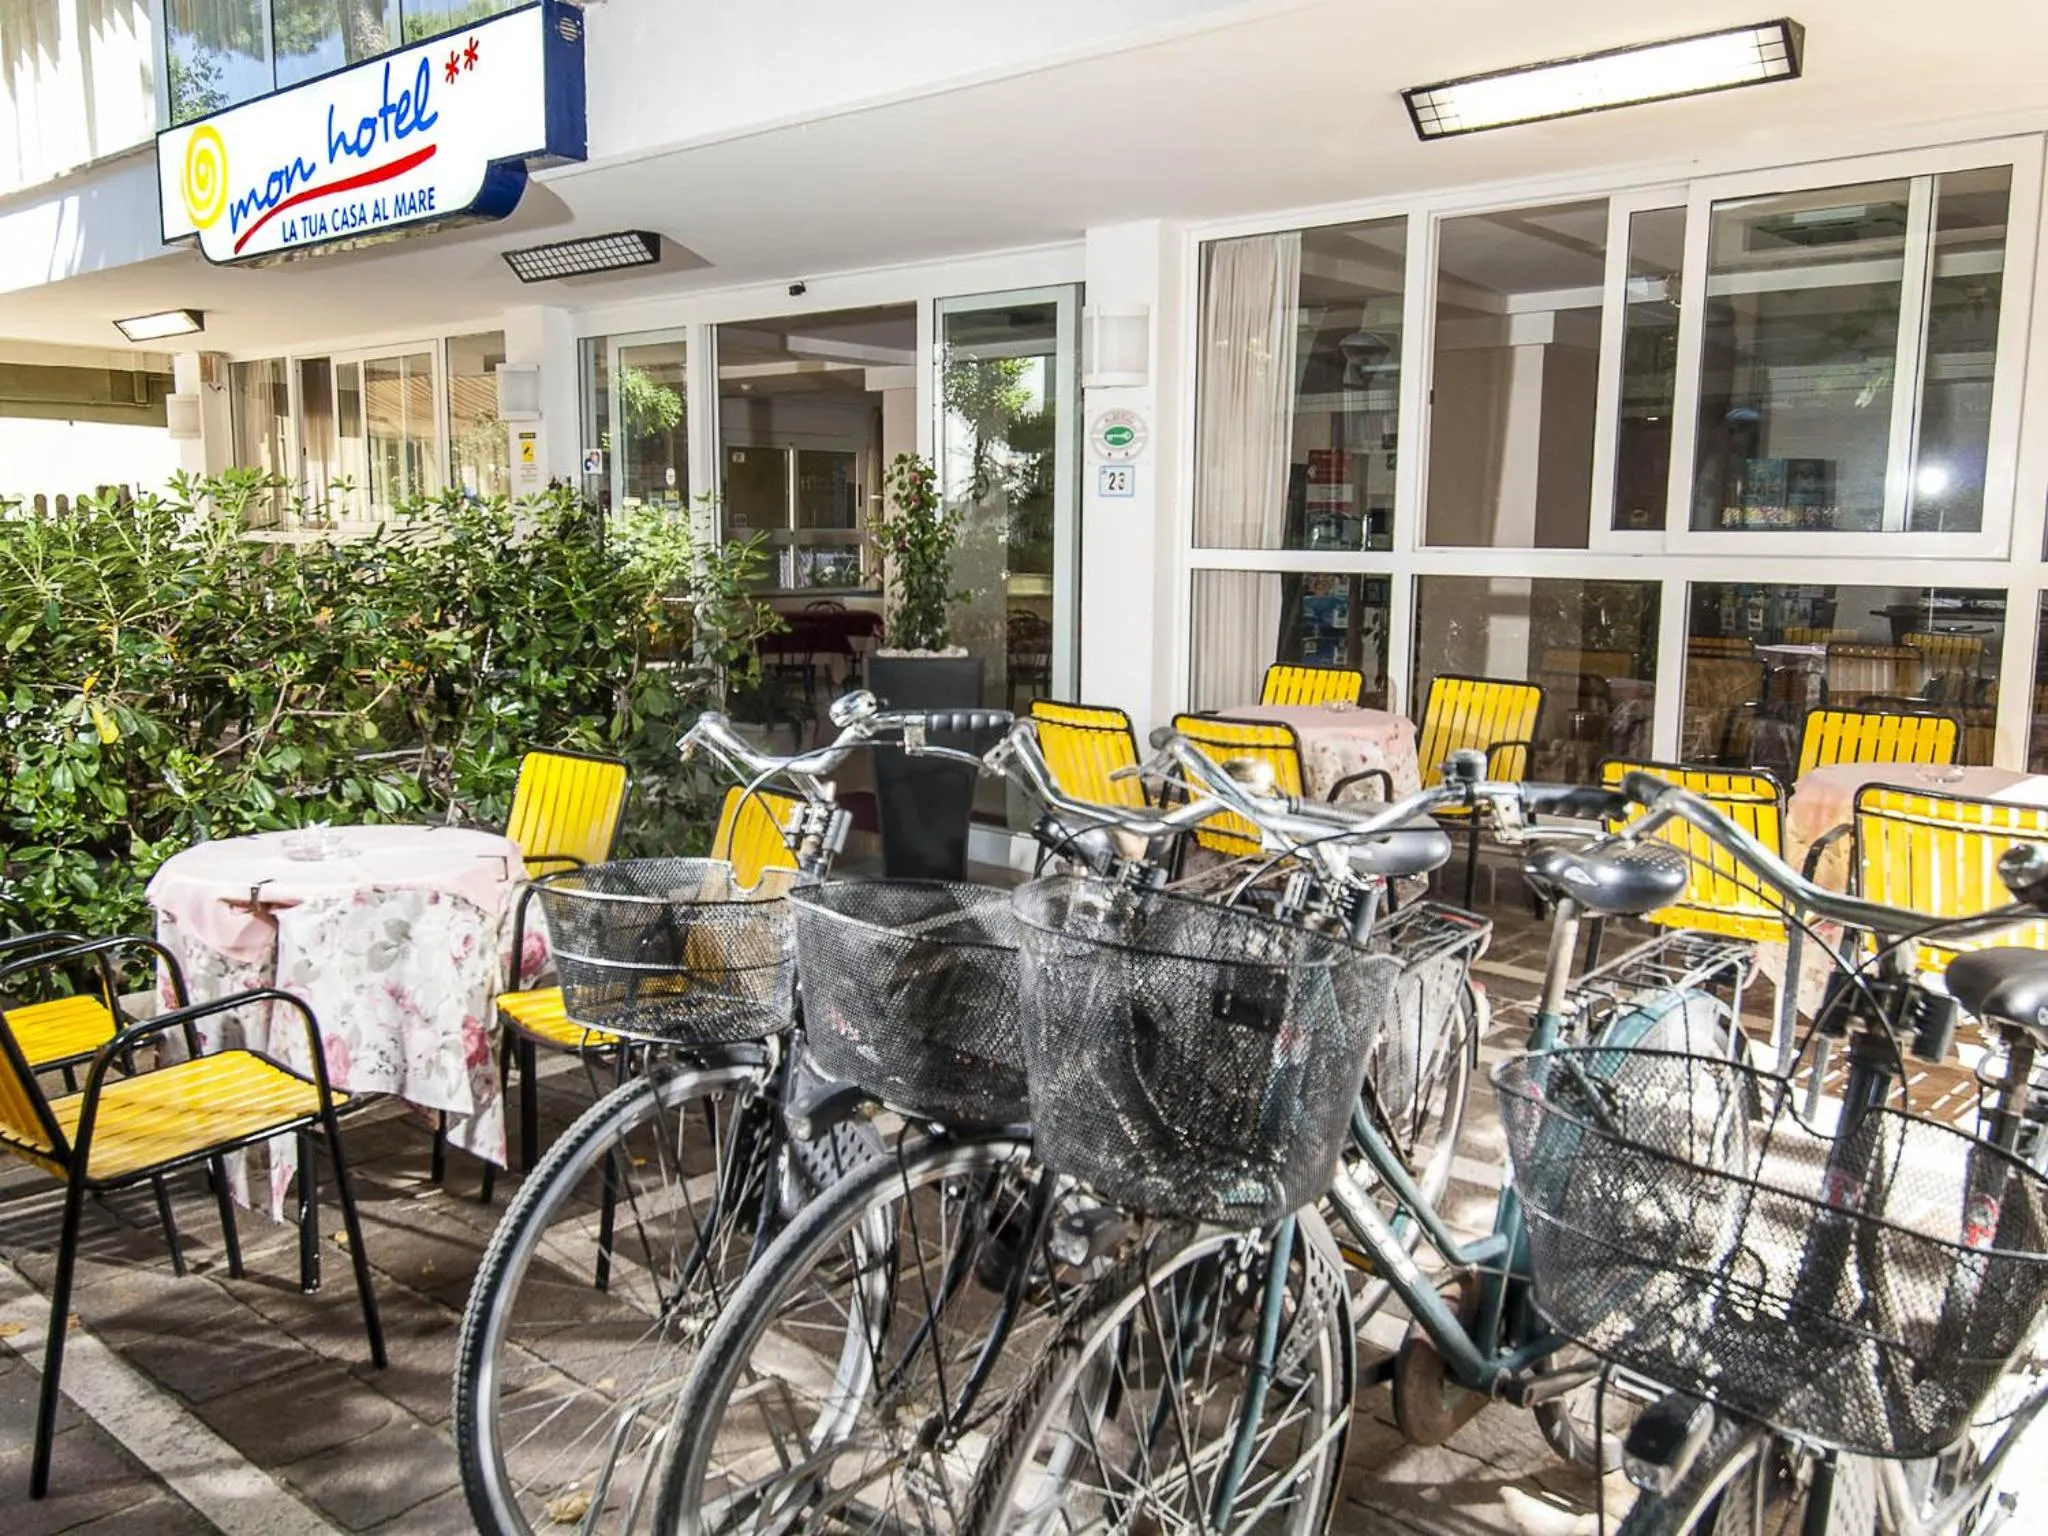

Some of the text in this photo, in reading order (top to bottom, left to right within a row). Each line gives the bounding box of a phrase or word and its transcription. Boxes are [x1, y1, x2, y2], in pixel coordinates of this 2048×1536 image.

[229, 55, 439, 234] mon hotel
[281, 186, 436, 243] LA TUA CASA AL MARE
